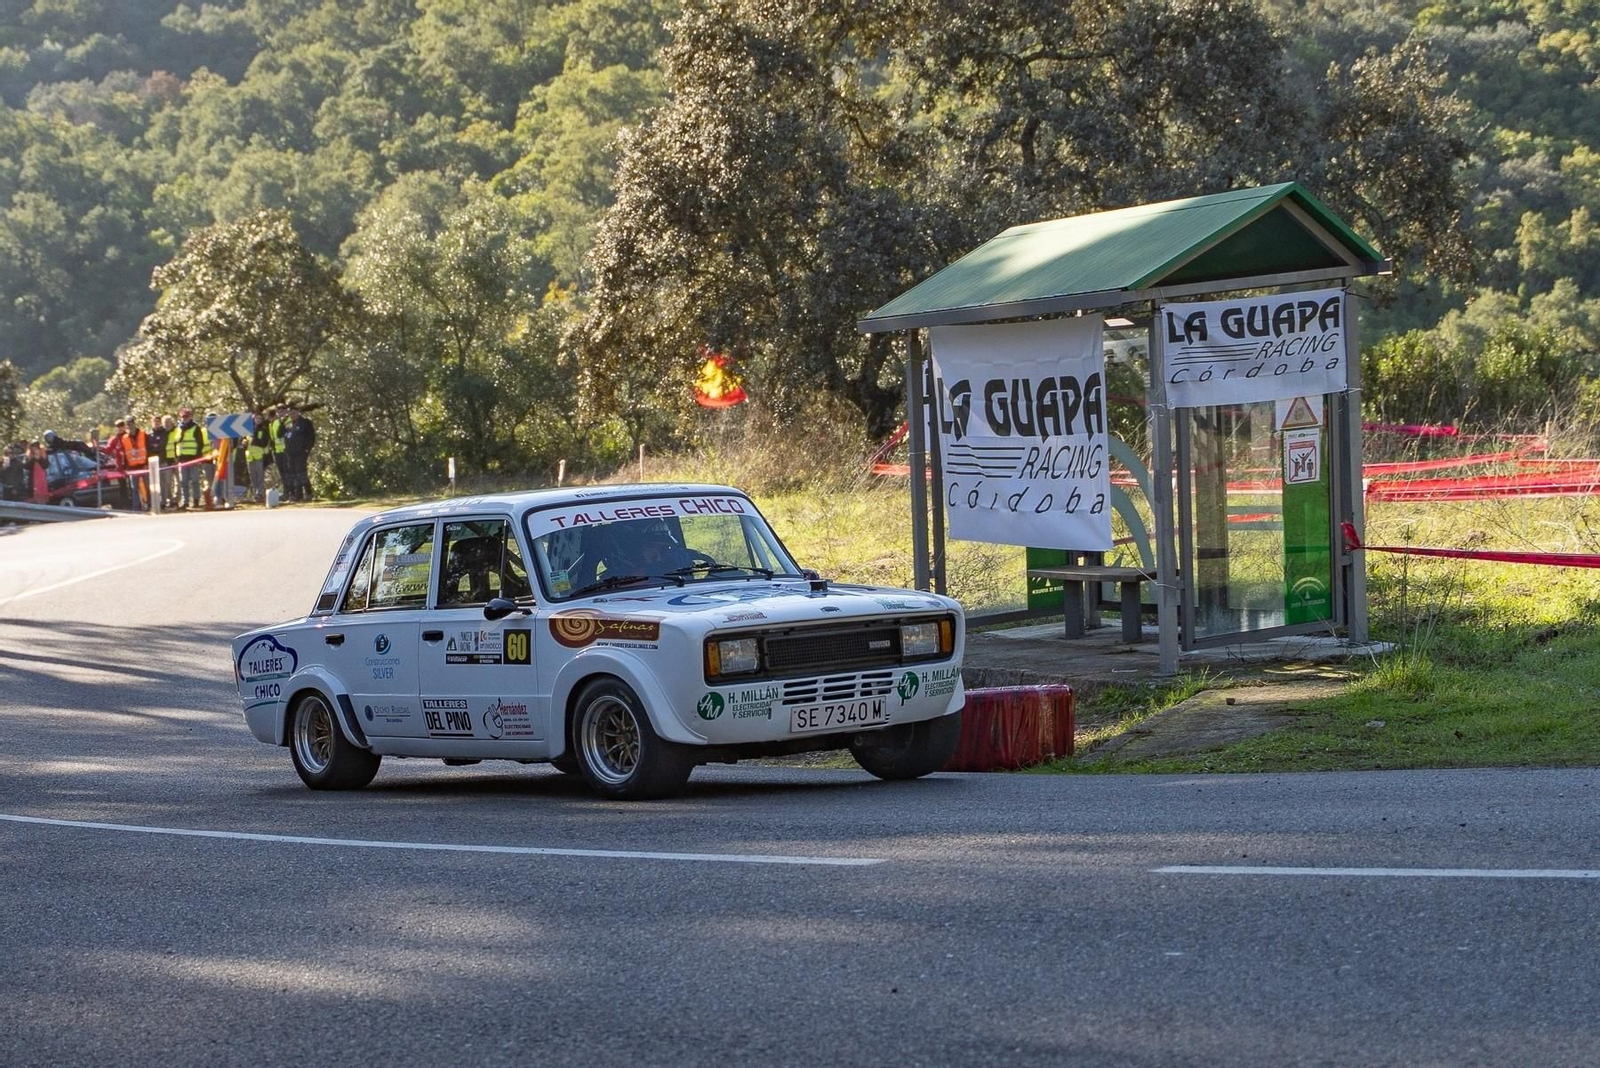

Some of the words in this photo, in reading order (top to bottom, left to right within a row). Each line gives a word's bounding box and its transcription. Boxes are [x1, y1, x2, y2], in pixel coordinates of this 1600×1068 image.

[1166, 311, 1208, 345] LA
[1220, 296, 1340, 339] GUAPA
[1255, 333, 1340, 360] RACING
[1170, 357, 1340, 384] Córdoba
[937, 378, 972, 441] LA
[984, 372, 1103, 443] GUAPA
[1018, 444, 1103, 480] RACING
[550, 505, 676, 528] TALLERES
[679, 499, 746, 514] CHICO
[507, 633, 527, 661] 60
[248, 658, 283, 675] TALLERES
[372, 667, 395, 680] SILVER
[921, 672, 930, 683] H.
[255, 683, 281, 700] CHICO
[728, 692, 738, 704] H.
[741, 685, 779, 703] MILLÁN
[423, 700, 467, 709] TALLERES
[738, 708, 771, 719] SERVICIO
[797, 707, 820, 728] SE
[824, 703, 868, 726] 7340
[872, 700, 882, 719] M
[424, 711, 445, 731] DEL
[445, 711, 472, 731] PINO
